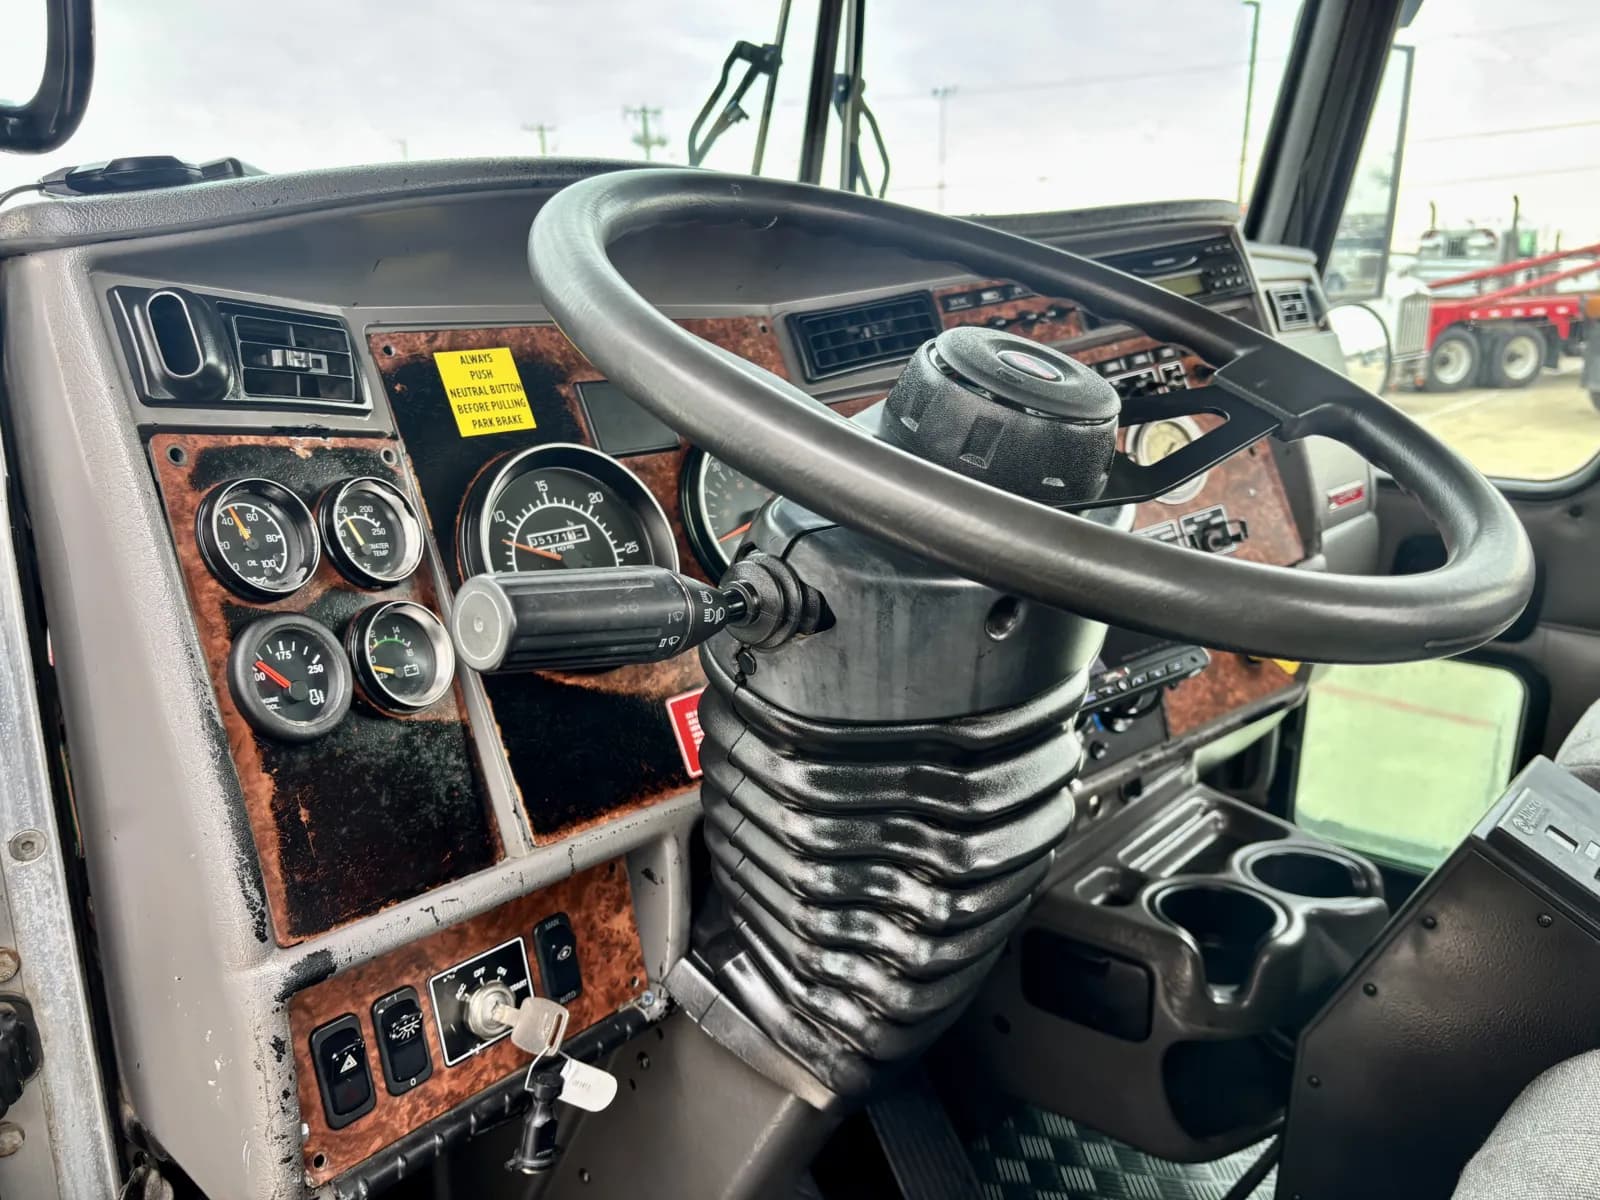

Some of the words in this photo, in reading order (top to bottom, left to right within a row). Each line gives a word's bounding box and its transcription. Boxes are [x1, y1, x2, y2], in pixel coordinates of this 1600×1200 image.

[460, 353, 493, 365] ALWAYS
[469, 369, 493, 380] PUSH
[449, 386, 488, 399] NEUTRAL
[489, 382, 523, 395] BUTTON
[457, 404, 490, 415] BEFORE
[491, 398, 527, 410] PULLING
[471, 417, 495, 429] PARK
[495, 414, 524, 426] BRAKE
[535, 480, 549, 493] 15
[587, 491, 604, 504] 20
[359, 505, 374, 513] 200
[221, 517, 234, 526] 40
[245, 512, 259, 522] 60
[493, 510, 507, 523] 10
[371, 527, 386, 536] 250
[265, 534, 279, 543] 80
[368, 542, 389, 550] WATER
[624, 540, 639, 554] 25
[372, 549, 389, 557] TEMP
[233, 562, 240, 571] 0
[261, 560, 277, 568] 100
[275, 651, 292, 660] 175
[307, 664, 324, 675] 250
[473, 966, 486, 978] OFF
[496, 966, 508, 977] ON
[509, 978, 528, 992] START
[455, 982, 467, 1000] ACC
[559, 991, 577, 1005] AUTO
